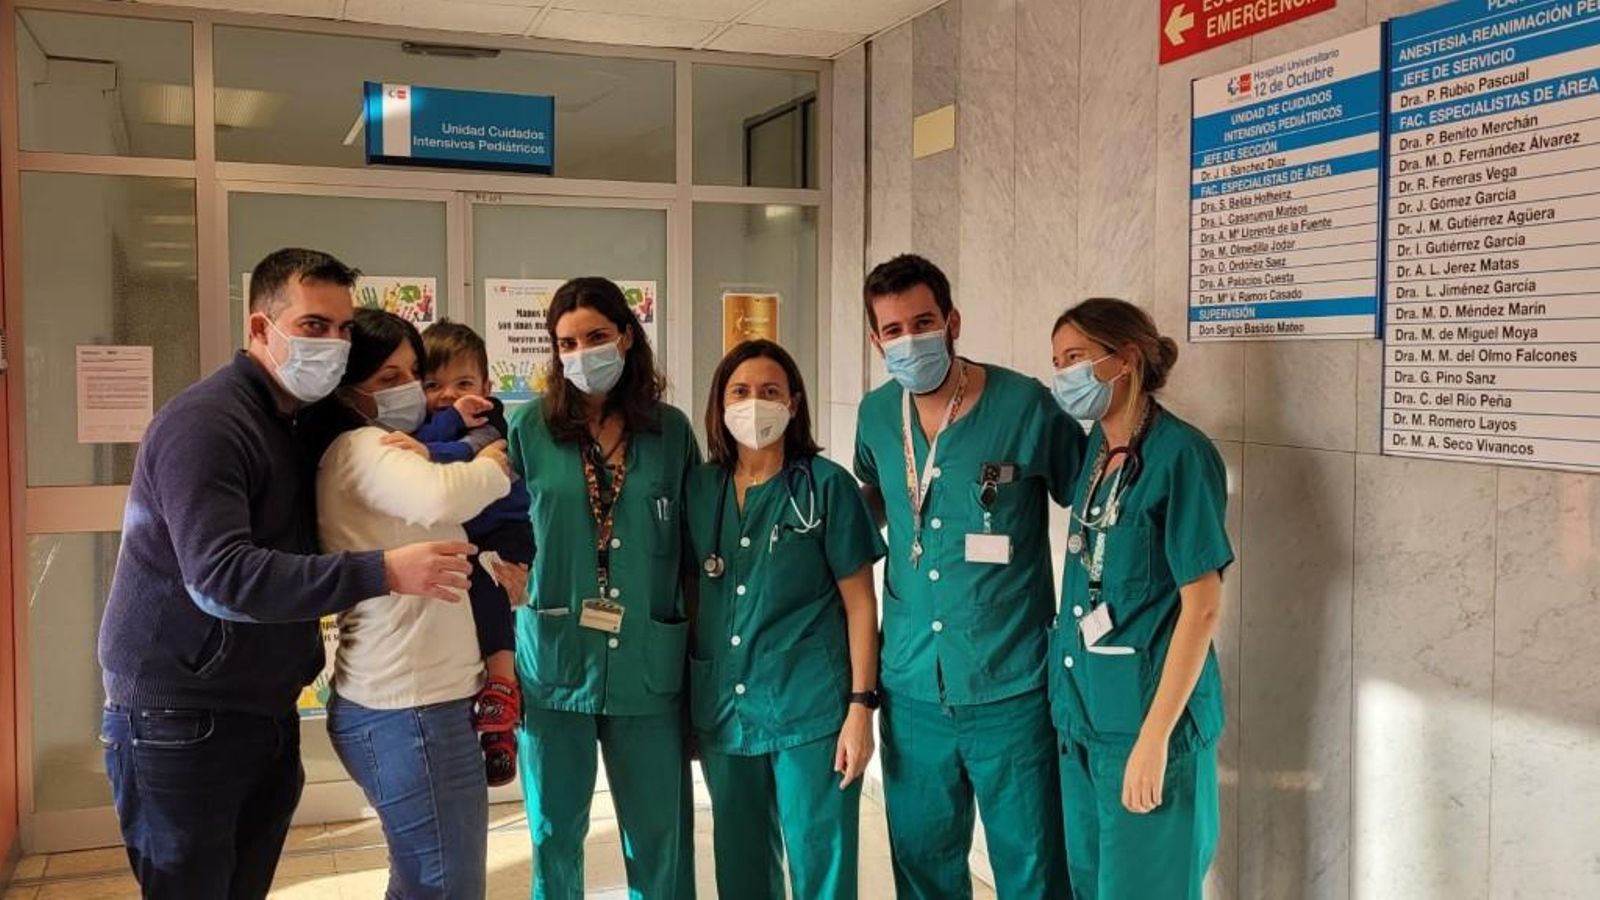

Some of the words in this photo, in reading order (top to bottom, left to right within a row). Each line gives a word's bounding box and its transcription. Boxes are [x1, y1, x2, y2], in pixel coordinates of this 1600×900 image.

[1207, 0, 1316, 38] EMERGEN
[1399, 3, 1573, 62] ANESTESIA-REANIMACIÓN
[1576, 0, 1600, 16] PE
[1254, 63, 1286, 82] Hospital
[1288, 48, 1340, 71] Universitario
[1401, 71, 1430, 87] JEFE
[1432, 64, 1449, 77] DE
[1452, 48, 1515, 75] SERVICIO
[1254, 83, 1266, 98] 12
[1269, 78, 1284, 93] de
[1287, 64, 1334, 89] Octubre
[1400, 94, 1424, 109] Dra.
[1427, 90, 1437, 102] P.
[1440, 83, 1475, 99] Rubio
[1479, 67, 1530, 91] Pascual
[1231, 108, 1265, 126] UNIDAD
[1267, 103, 1280, 116] DE
[1281, 89, 1333, 112] CUIDADOS
[1400, 113, 1427, 129] FAC.
[1429, 90, 1530, 125] ESPECIALISTAS
[1534, 86, 1554, 101] DE
[1556, 76, 1600, 97] ÁREA
[441, 122, 485, 137] Unidad
[488, 125, 545, 140] Cuidados
[1224, 121, 1276, 143] INTENSIVOS
[1278, 104, 1342, 131] PEDIÁTRICOS
[1400, 137, 1423, 151] Dra.
[1426, 133, 1435, 146] P.
[1439, 126, 1478, 144] Benito
[1481, 114, 1538, 132] Merchán
[413, 135, 476, 151] Intensivos
[479, 140, 545, 154] Pediátricos
[1201, 151, 1221, 165] JEFE
[1223, 148, 1235, 161] DE
[1237, 141, 1277, 160] SECCIÓN
[1399, 159, 1420, 172] Dra.
[1425, 155, 1440, 168] M.
[1443, 152, 1455, 165] D.
[1459, 140, 1526, 162] Fernández
[1529, 130, 1581, 149] Álvarez
[1221, 174, 1288, 193] ESPECIALISTAS
[1290, 170, 1304, 182] DE
[1305, 164, 1332, 179] ÁREA
[1399, 181, 1414, 193] Dr.
[1417, 178, 1429, 190] R.
[1432, 171, 1482, 188] Ferreras
[1486, 165, 1518, 182] Vega
[1399, 202, 1413, 214] Dr.
[1416, 199, 1426, 212] J.
[1430, 193, 1471, 210] Gómez
[1475, 187, 1517, 205] García
[1228, 209, 1274, 224] Casanueva
[1276, 204, 1309, 216] Mateos
[1398, 223, 1413, 235] Dr.
[1416, 221, 1427, 233] J.
[1429, 218, 1444, 232] M.
[1447, 212, 1504, 230] Gutiérrez
[1507, 207, 1555, 226] Agüera
[1277, 222, 1289, 234] de
[1290, 220, 1299, 232] la
[1301, 217, 1332, 231] Fuente
[1398, 245, 1413, 256] Dr.
[1425, 237, 1480, 254] Gutiérrez
[1483, 232, 1526, 249] García
[1397, 266, 1412, 277] Dr.
[1415, 264, 1427, 275] A.
[1430, 262, 1440, 275] L.
[1443, 259, 1476, 274] Jerez
[1480, 257, 1520, 272] Matas
[1264, 273, 1295, 284] Cuesta
[1396, 286, 1419, 299] Dra.
[1425, 285, 1437, 297] L.
[1439, 279, 1490, 297] Jiménez
[1493, 277, 1537, 293] García
[1239, 290, 1268, 301] Ramos
[1270, 288, 1303, 300] Casado
[516, 308, 541, 318] Manos
[1199, 305, 1256, 319] SUPERVISIÓN
[1396, 308, 1419, 320] Dra.
[1422, 306, 1436, 319] M.
[1439, 305, 1452, 318] D.
[1455, 303, 1505, 317] Méndez
[1508, 301, 1546, 316] Marín
[1199, 325, 1214, 335] Don
[1216, 324, 1242, 337] Sergio
[1244, 322, 1275, 334] Basildo
[1277, 321, 1305, 333] Mateo
[1395, 328, 1418, 341] Dra.
[1421, 328, 1435, 341] M.
[1439, 327, 1454, 340] de
[1457, 326, 1499, 343] Miguel
[1502, 325, 1538, 342] Moya
[1394, 350, 1417, 362] Dra.
[1421, 349, 1435, 362] M.
[1438, 349, 1453, 362] M.
[1456, 348, 1475, 362] del
[1478, 348, 1512, 362] Olmo
[1515, 347, 1578, 363] Falcones
[1394, 371, 1417, 384] Dra.
[1420, 371, 1432, 384] G.
[1436, 371, 1463, 384] Pino
[1466, 371, 1496, 385] Sanz
[1393, 392, 1417, 405] Dra.
[1419, 392, 1432, 406] C.
[1435, 393, 1454, 406] del
[1456, 393, 1478, 407] Río
[1480, 394, 1512, 408] Peña
[1393, 413, 1408, 425] Dr.
[1411, 413, 1426, 426] M.
[1428, 414, 1476, 429] Romero
[1479, 416, 1517, 433] Layos
[1392, 434, 1408, 446] Dr.
[1411, 435, 1425, 447] M.
[1428, 436, 1440, 449] A.
[1443, 436, 1473, 451] Seco
[1476, 439, 1535, 455] Vivancos
